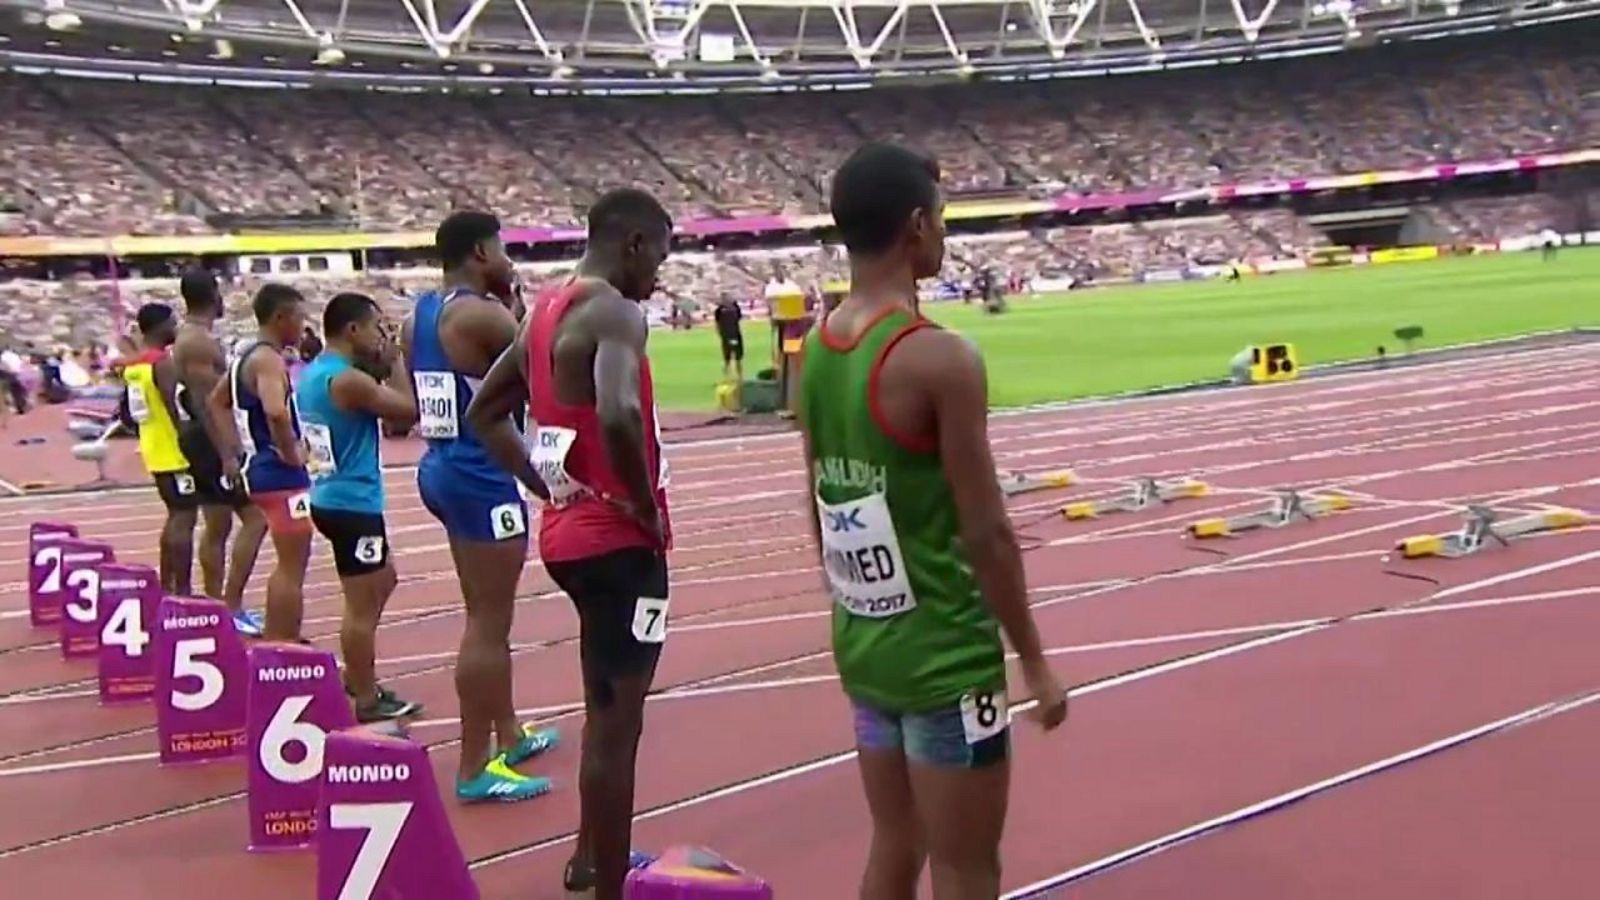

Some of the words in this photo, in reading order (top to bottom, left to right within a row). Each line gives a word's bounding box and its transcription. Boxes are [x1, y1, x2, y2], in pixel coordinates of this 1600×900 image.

[500, 510, 516, 532] 6
[362, 542, 375, 559] 5
[35, 547, 62, 594] 2
[66, 569, 99, 622] 3
[102, 598, 149, 656] 4
[164, 615, 219, 630] MONDO
[645, 608, 661, 636] 7
[171, 637, 224, 711] 5
[259, 665, 325, 681] MONDO
[975, 689, 998, 728] 8
[260, 694, 326, 783] 6
[328, 764, 410, 783] MONDO
[330, 802, 414, 900] 7
